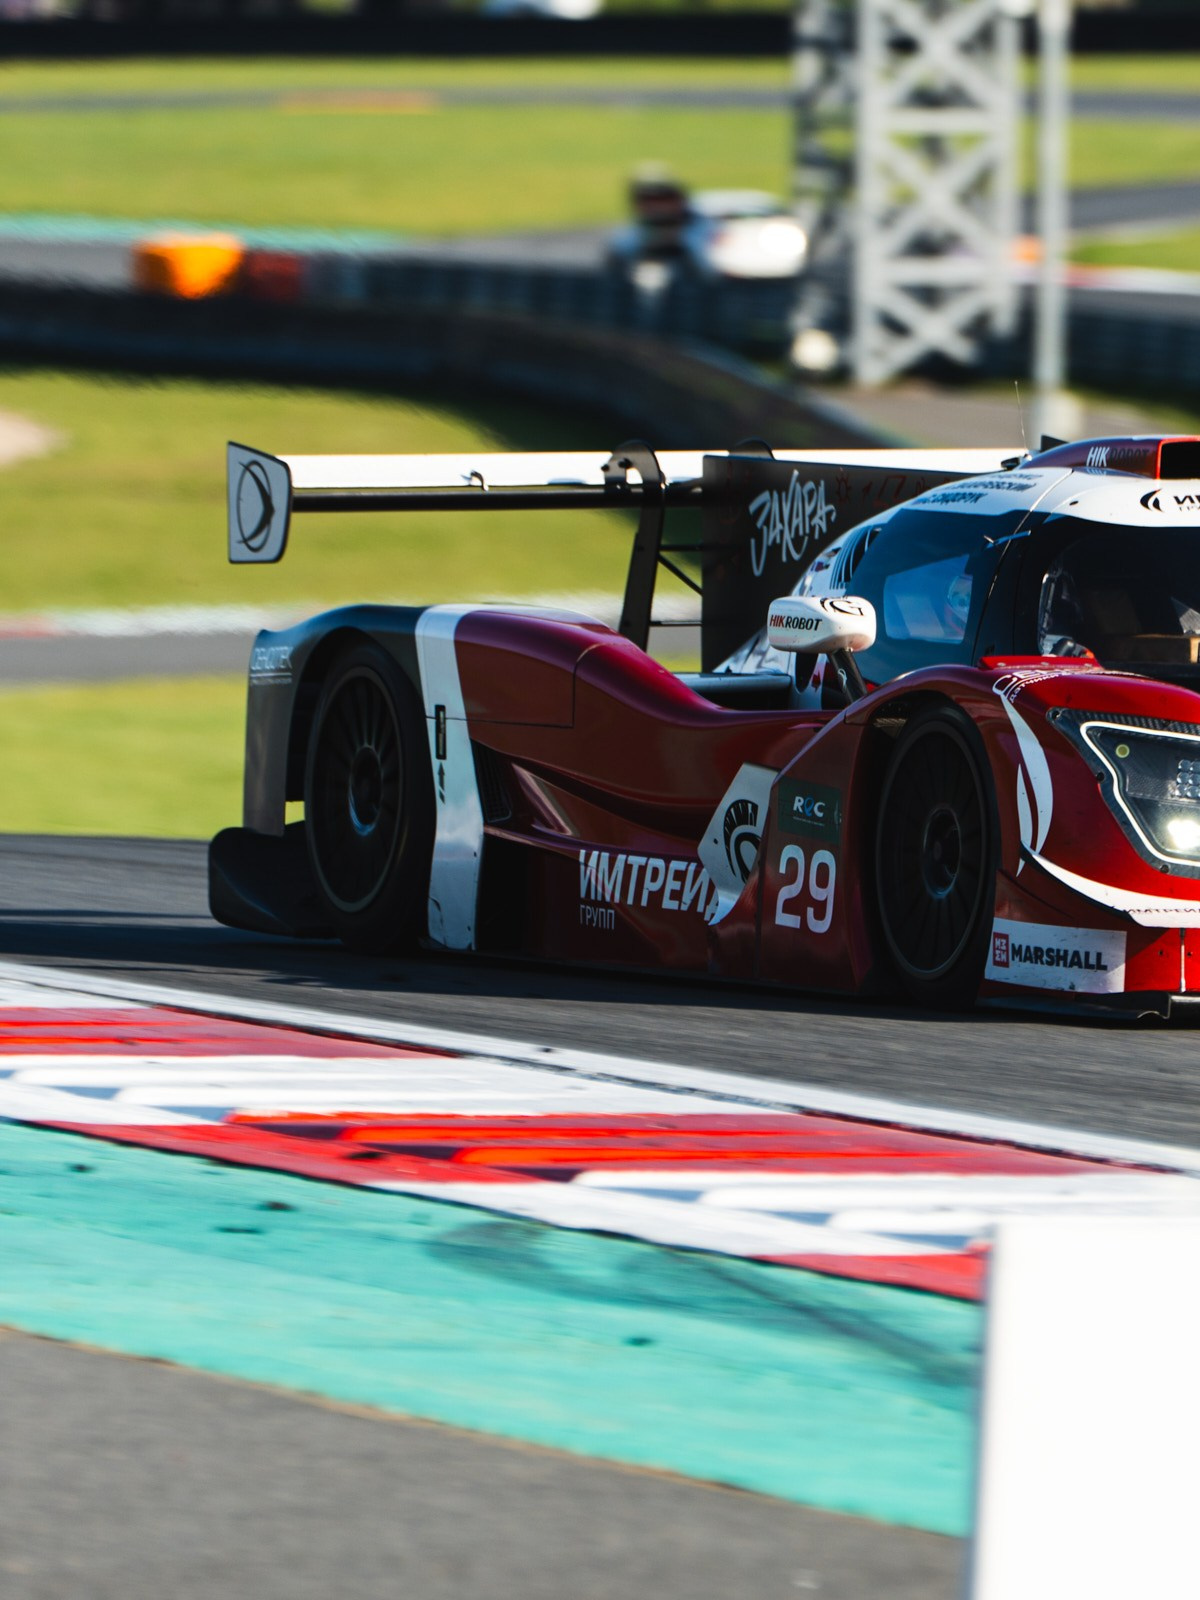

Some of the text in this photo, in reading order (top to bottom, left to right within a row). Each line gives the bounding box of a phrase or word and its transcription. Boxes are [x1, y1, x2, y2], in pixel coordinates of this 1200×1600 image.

[769, 613, 822, 632] HIKROBOT
[775, 844, 837, 934] 29
[579, 904, 616, 930] ГРУПП
[1011, 943, 1108, 971] MARSHALL
